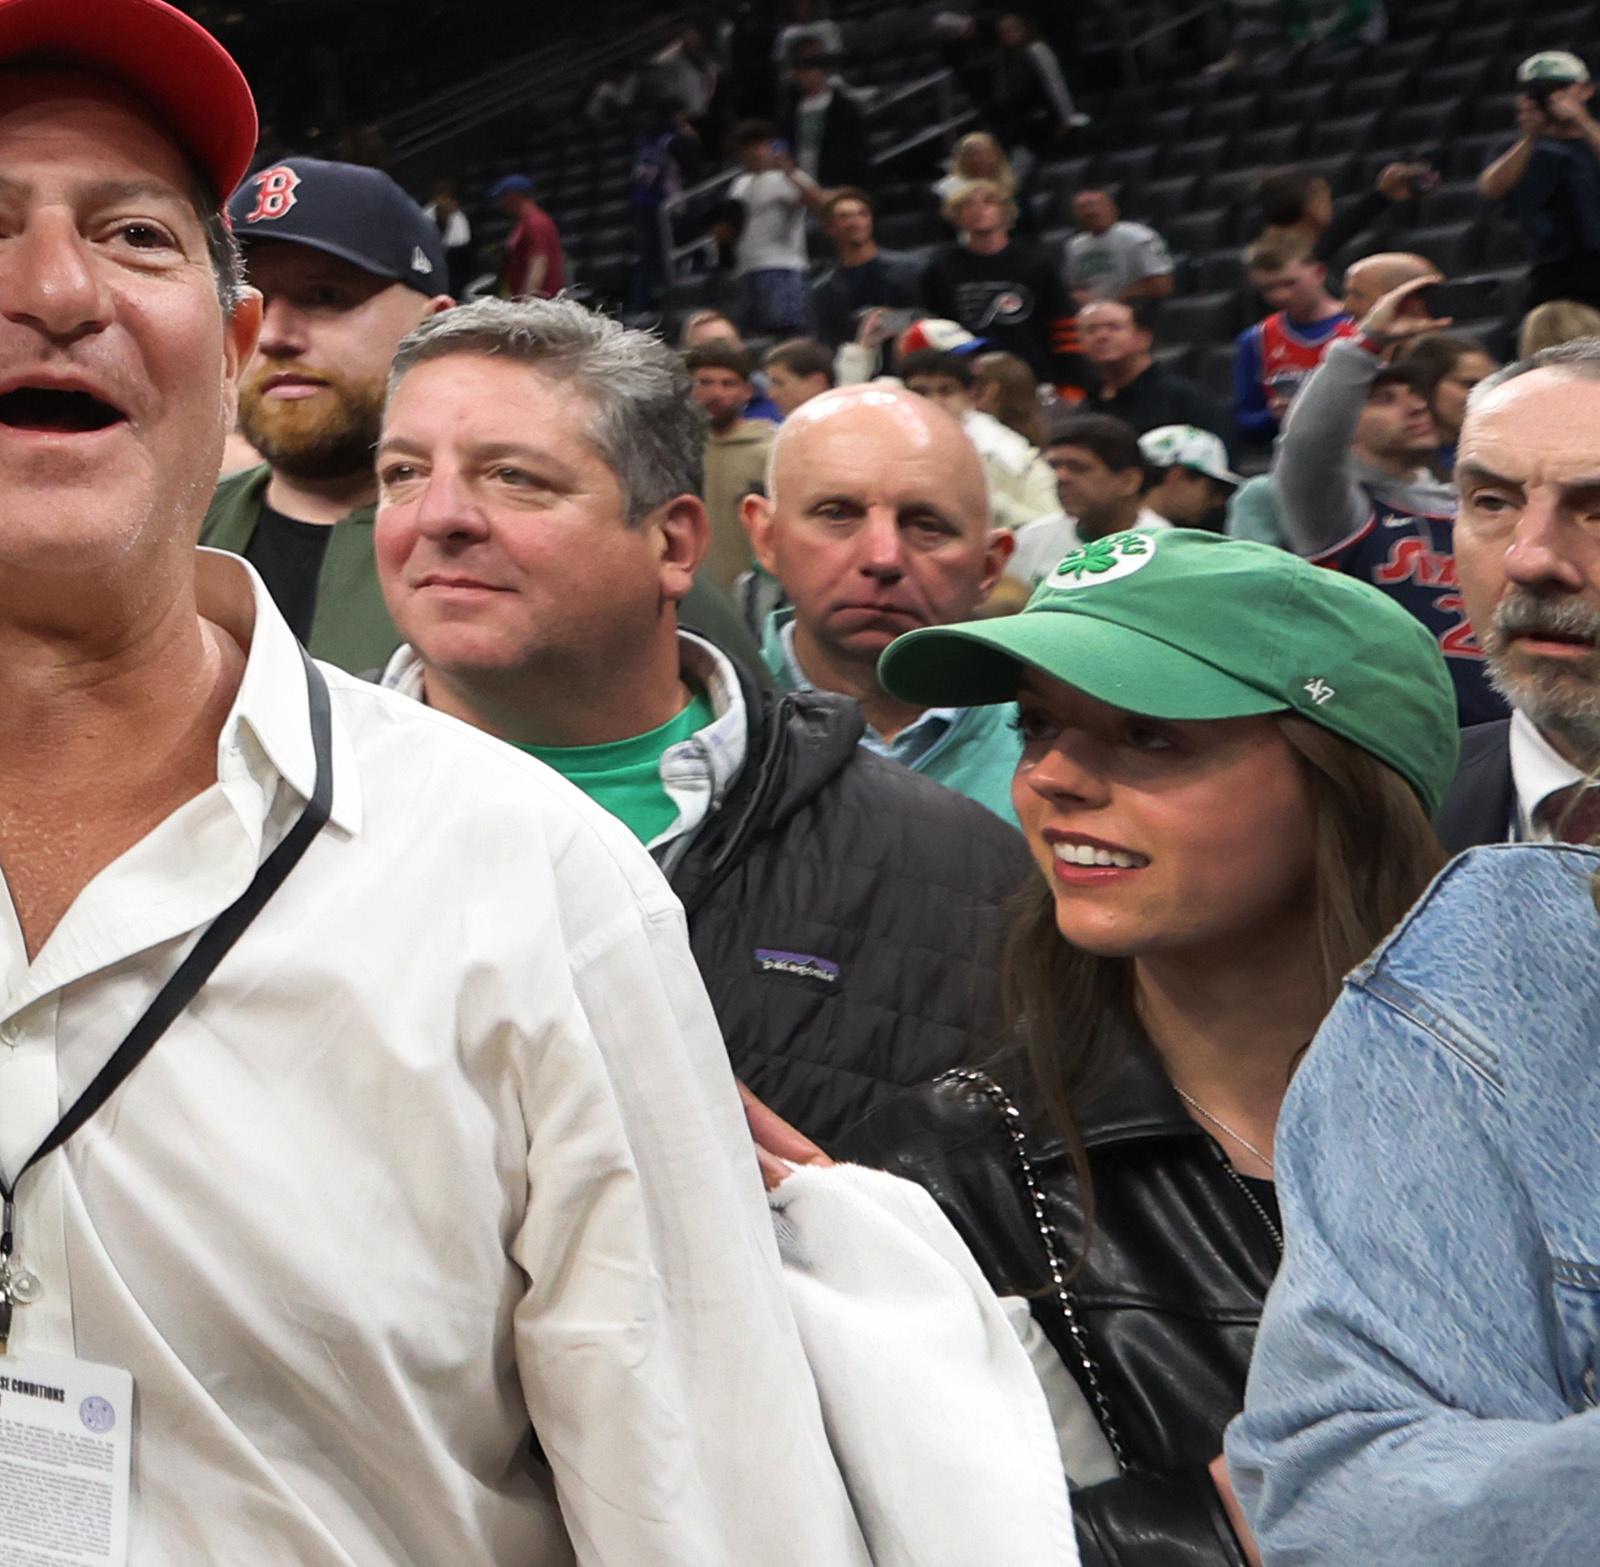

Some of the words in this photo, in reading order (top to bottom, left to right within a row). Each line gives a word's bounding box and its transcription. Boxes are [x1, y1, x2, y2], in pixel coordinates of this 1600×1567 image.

[246, 165, 302, 224] B
[762, 960, 835, 982] patagonia
[11, 1379, 66, 1404] CONDITIONS
